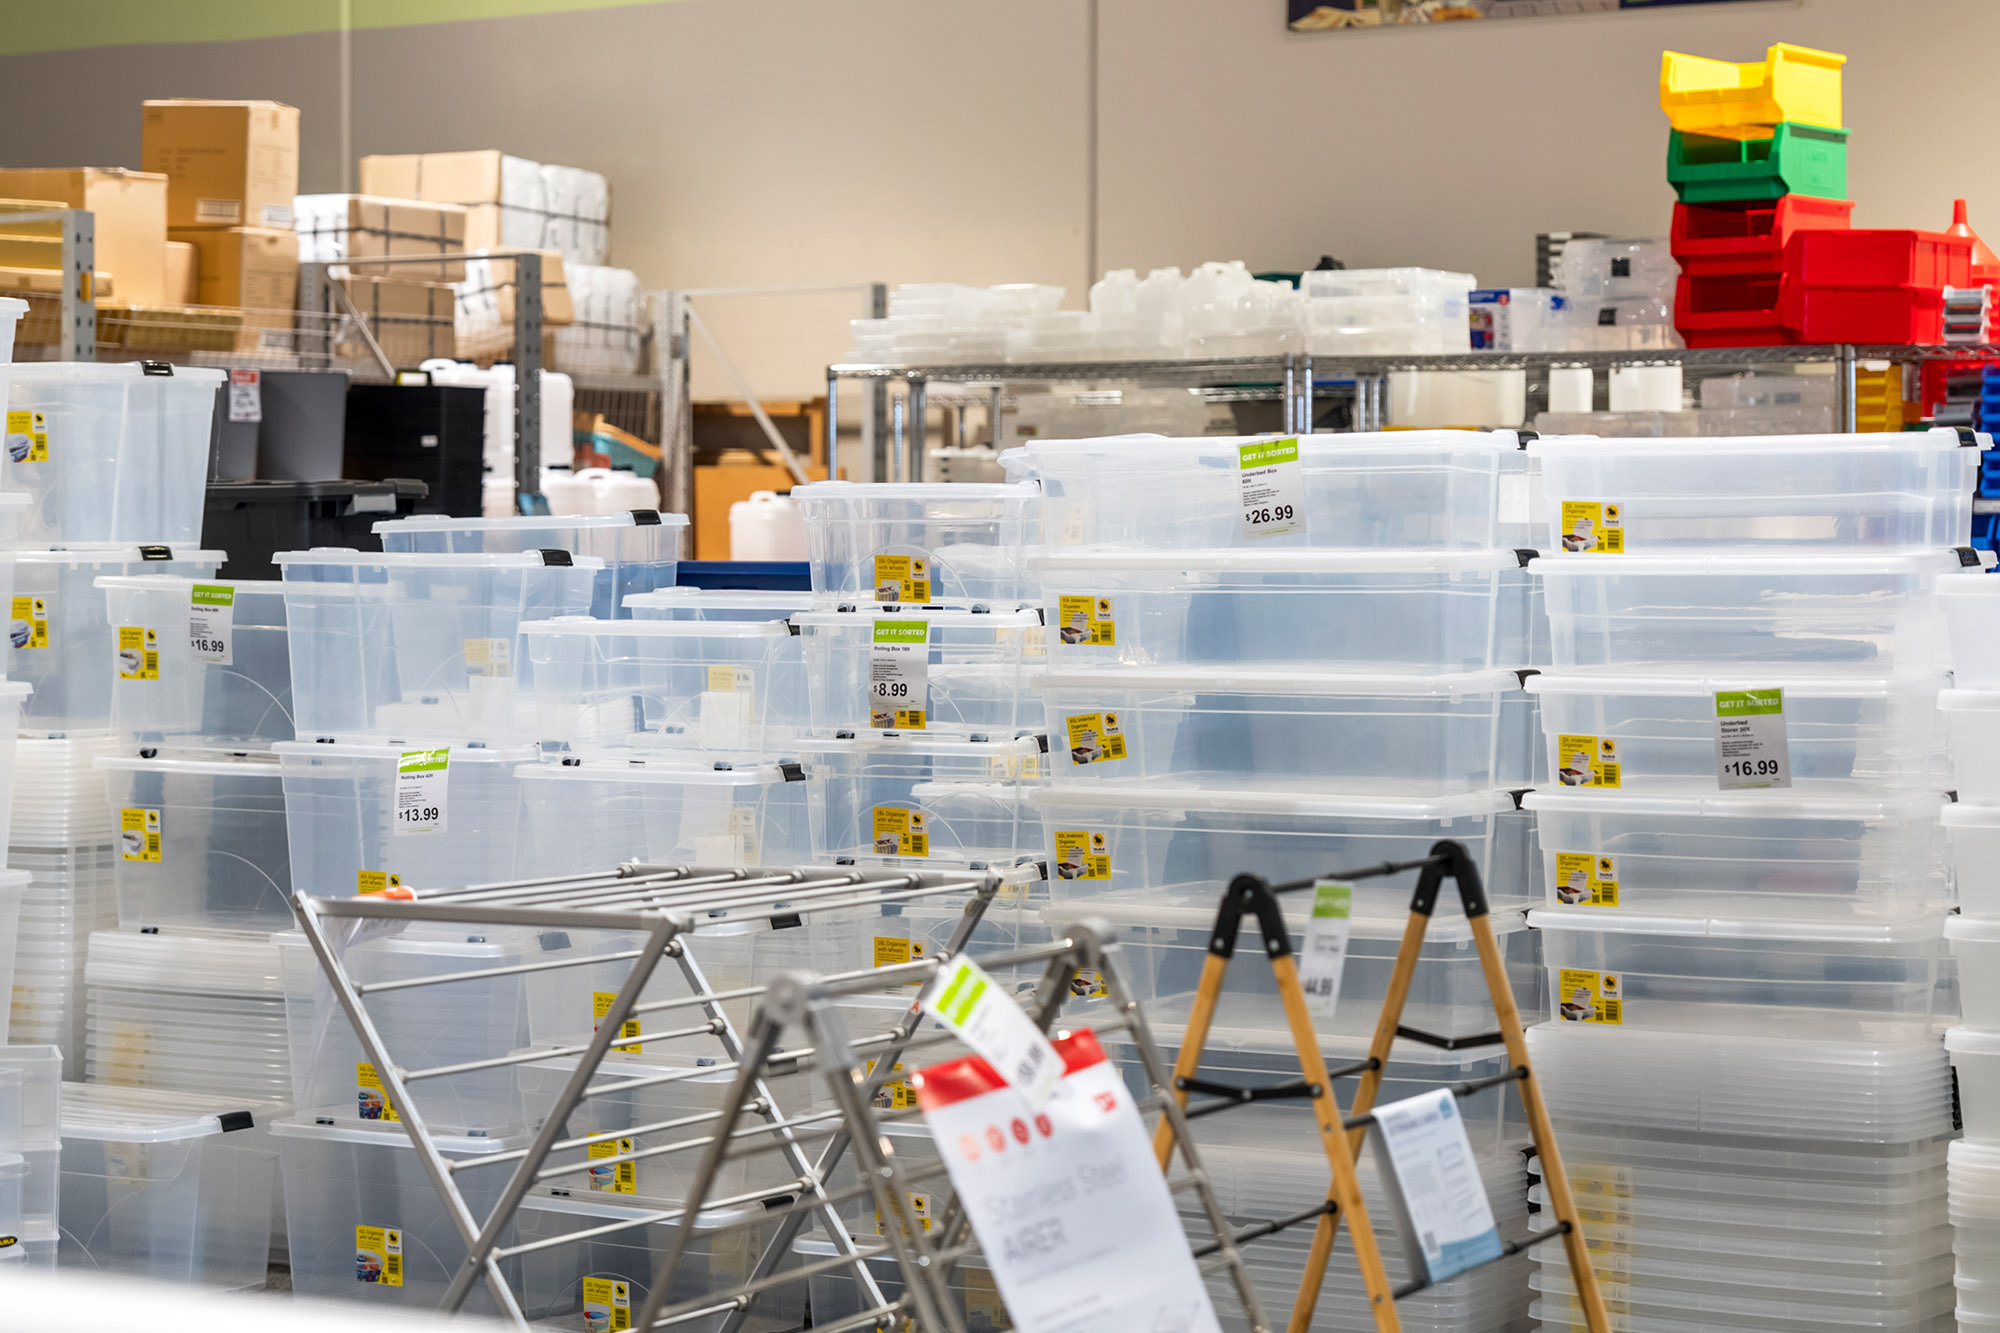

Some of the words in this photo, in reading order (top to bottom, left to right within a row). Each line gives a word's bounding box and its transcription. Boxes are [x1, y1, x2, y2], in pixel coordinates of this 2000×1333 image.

[1242, 453, 1256, 461] GET
[1258, 451, 1265, 459] IT
[1267, 447, 1295, 457] SORTED
[1241, 470, 1266, 478] Underbed
[1245, 504, 1293, 524] $26.99
[211, 592, 232, 600] SORTED
[191, 639, 224, 652] $16.99
[873, 683, 907, 697] $8.99
[1719, 700, 1734, 708] GET
[1736, 700, 1744, 708] IT
[1746, 698, 1779, 707] SORTED
[1724, 759, 1778, 776] $16.99
[399, 807, 439, 822] $13.99
